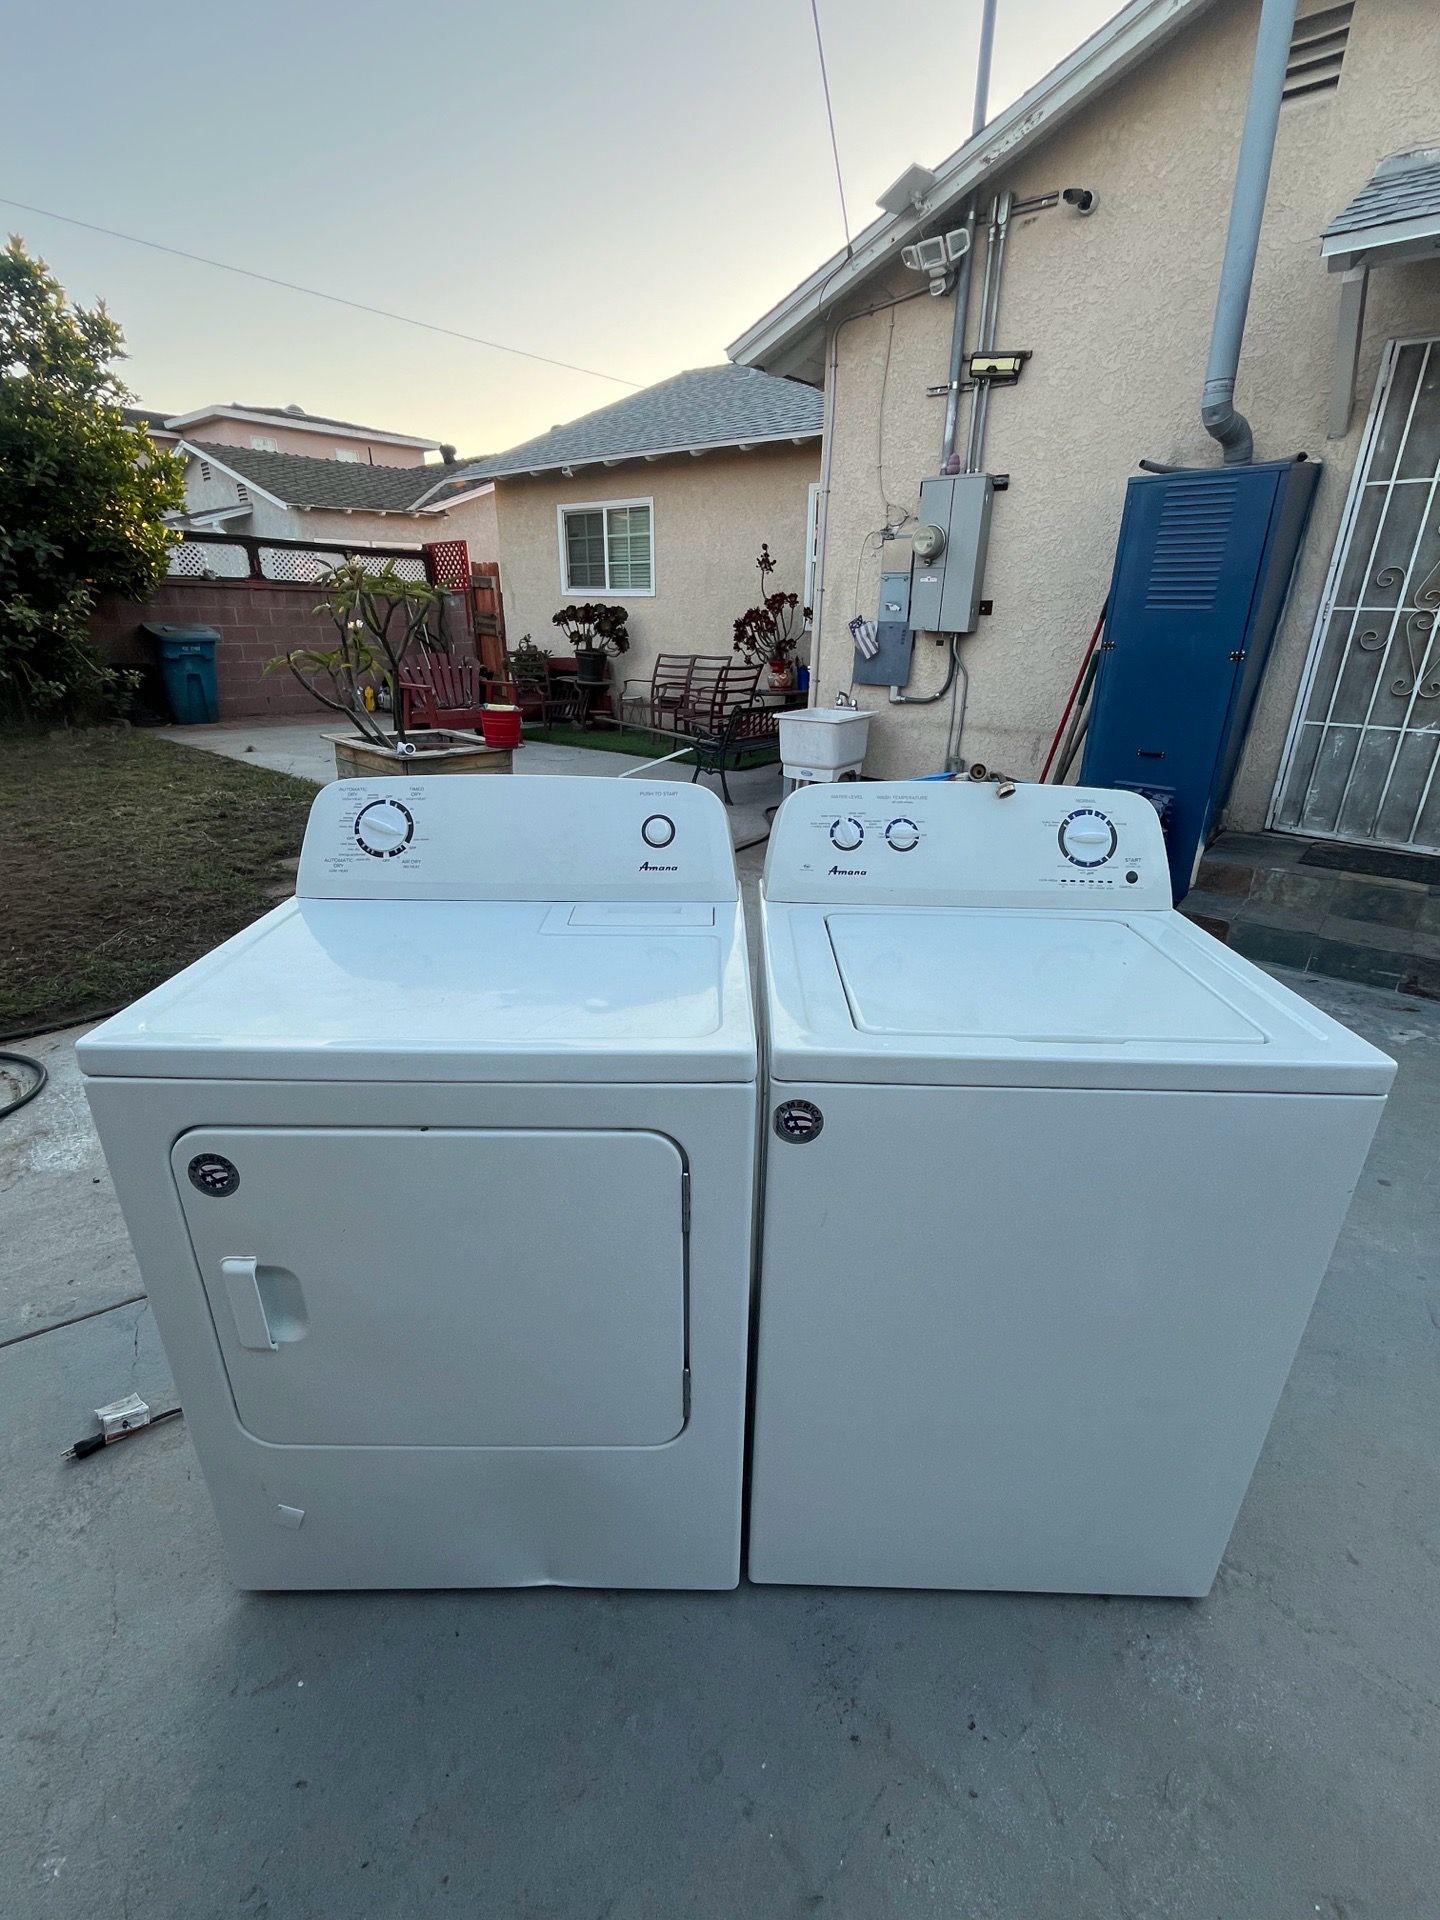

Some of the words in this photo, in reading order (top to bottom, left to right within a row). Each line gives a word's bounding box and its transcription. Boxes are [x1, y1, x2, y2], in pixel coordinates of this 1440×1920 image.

[638, 861, 679, 872] Amana
[827, 865, 867, 876] Amana
[779, 1101, 822, 1123] AMERICA
